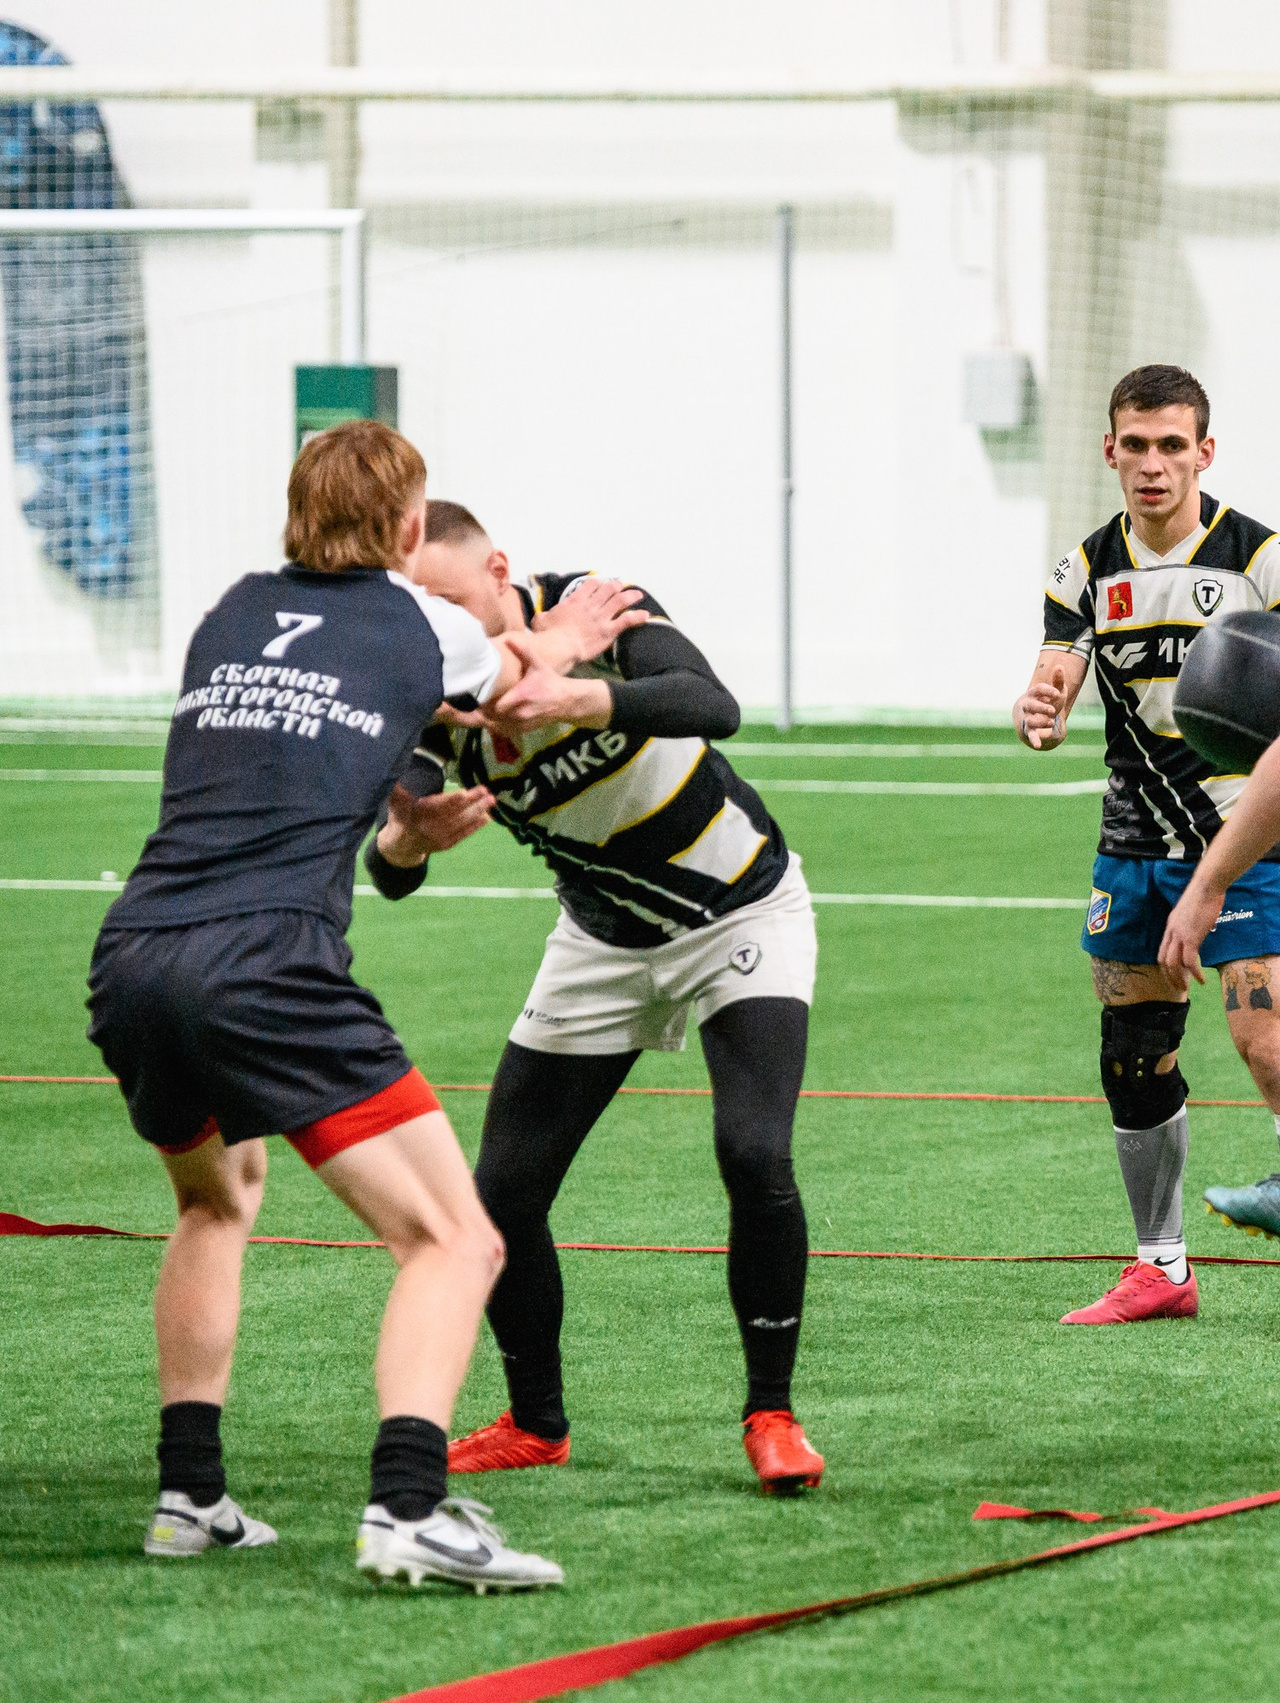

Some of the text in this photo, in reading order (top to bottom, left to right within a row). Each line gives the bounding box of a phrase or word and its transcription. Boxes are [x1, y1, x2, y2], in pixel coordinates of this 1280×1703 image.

[262, 612, 323, 659] 7
[210, 663, 341, 696] СБОРНАЯ
[196, 707, 322, 740] ОБЛАСТИ
[539, 730, 628, 789] МКБ
